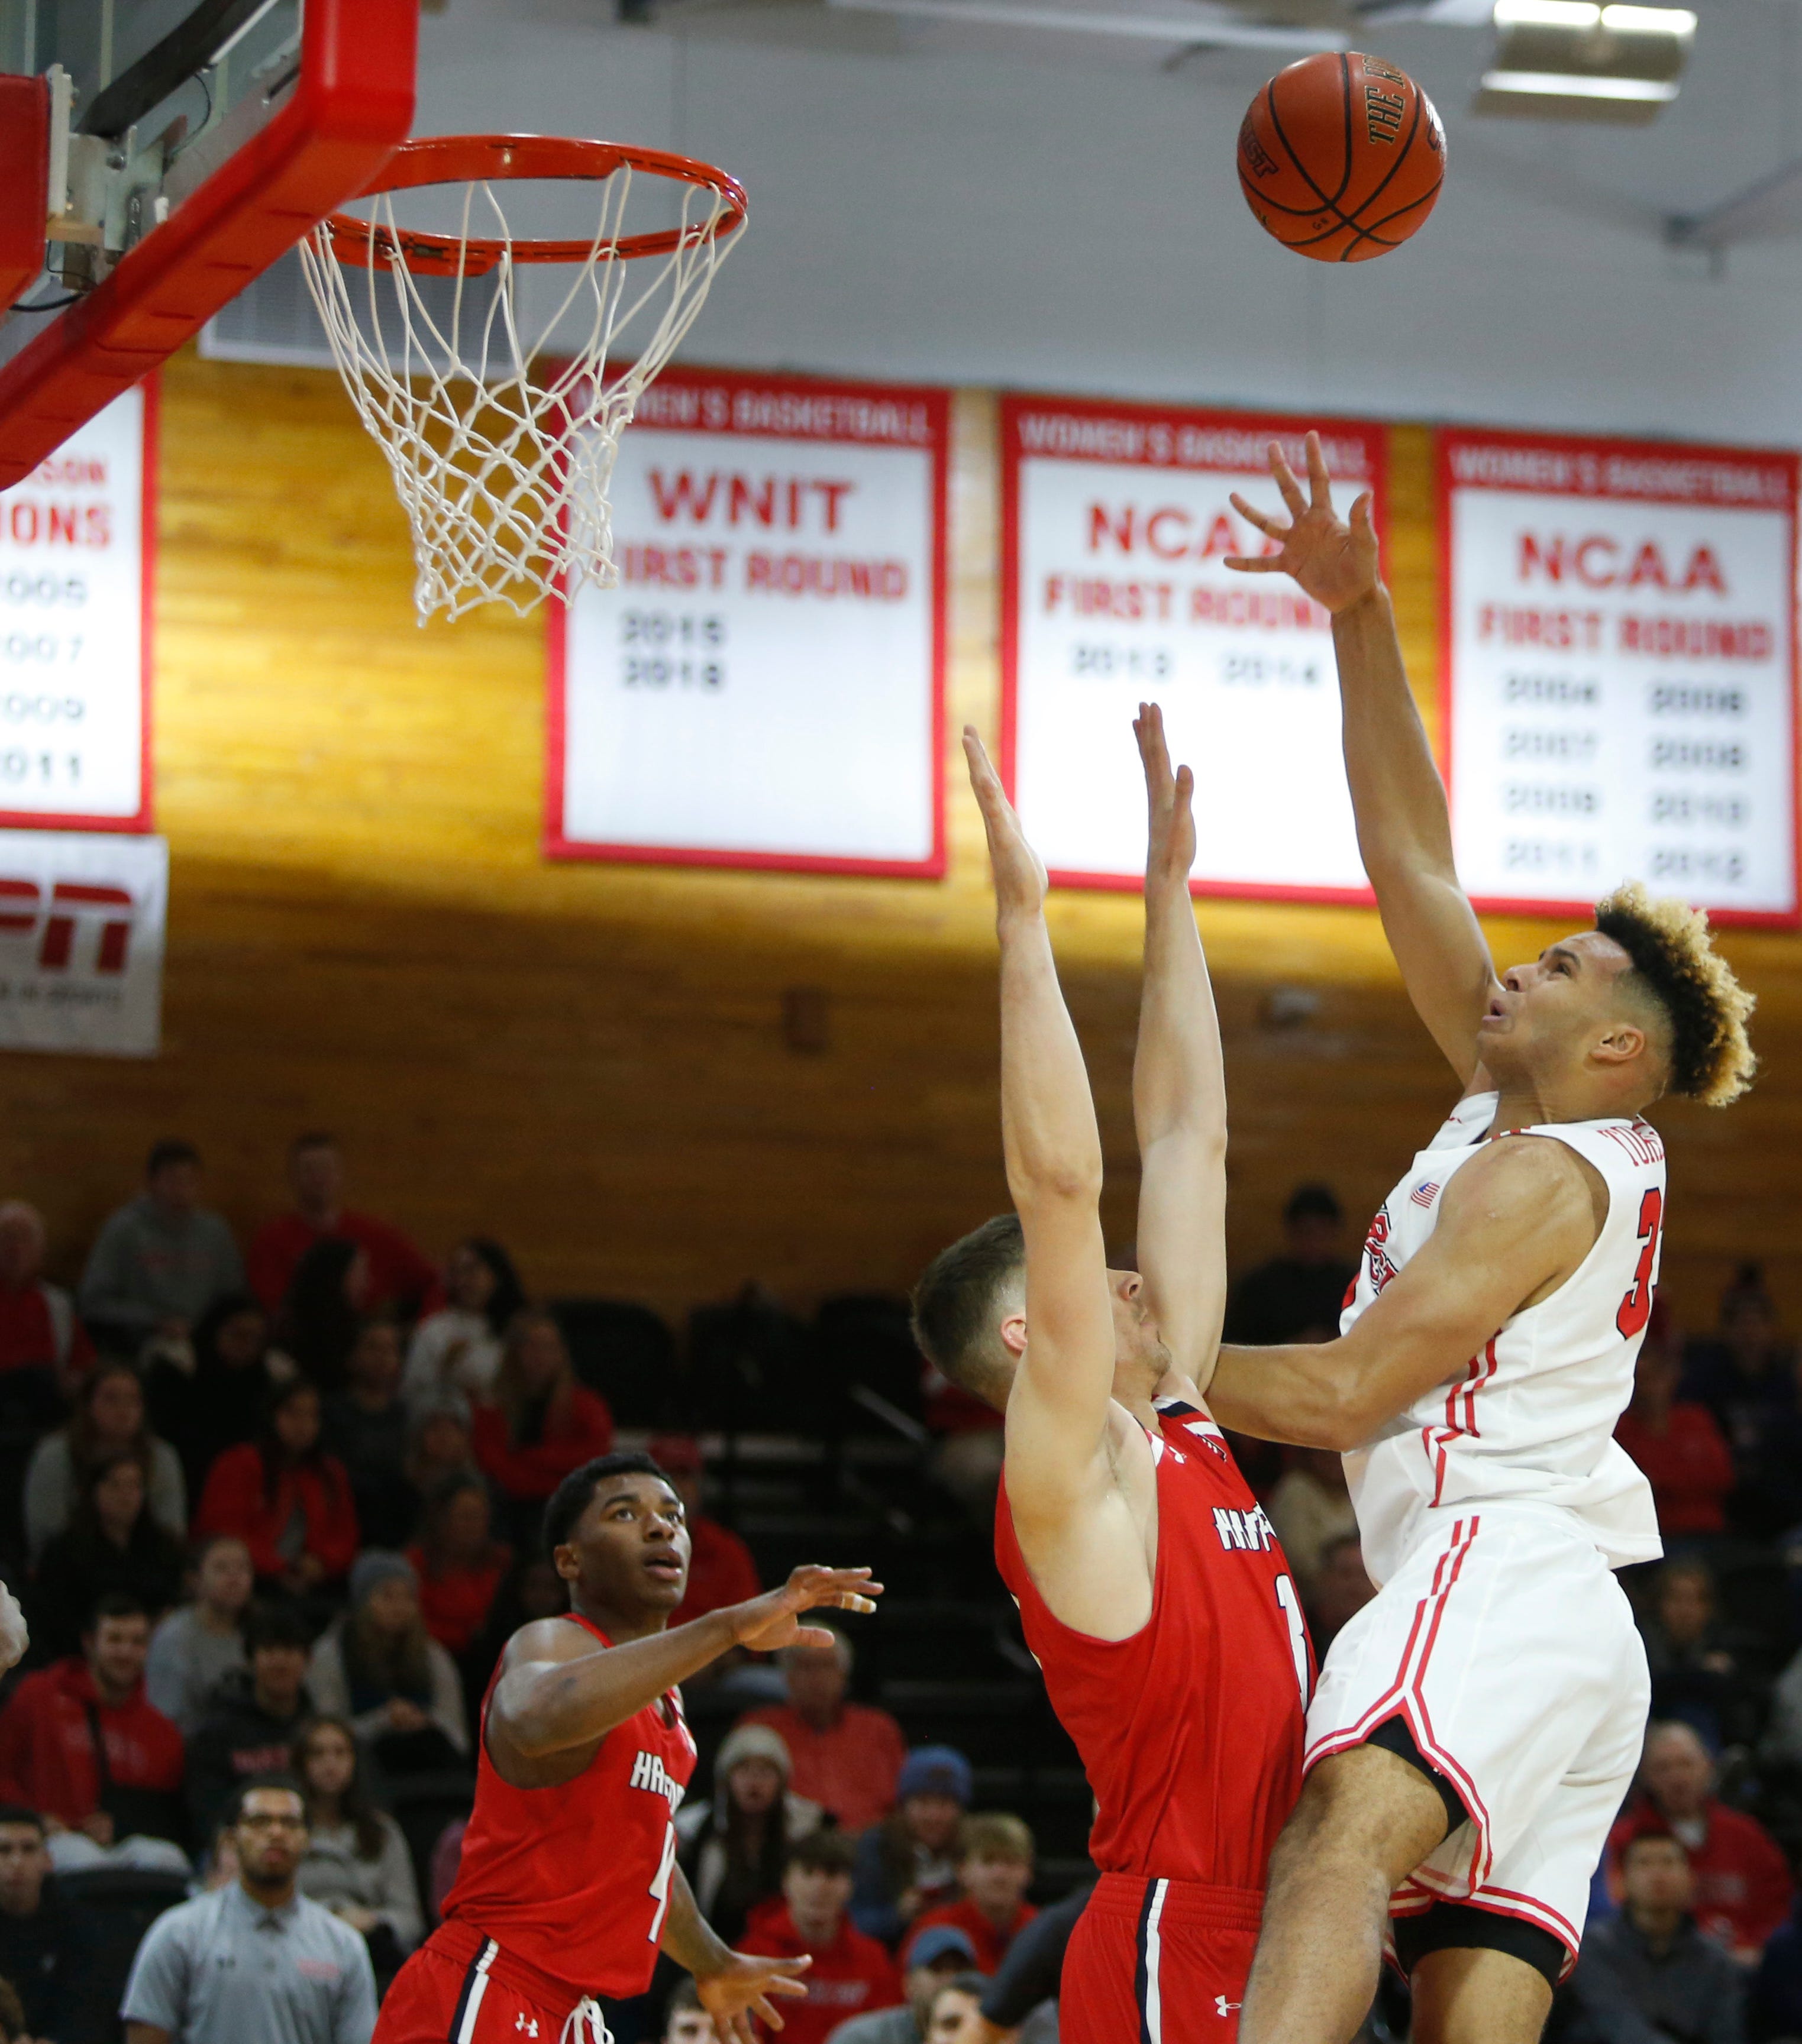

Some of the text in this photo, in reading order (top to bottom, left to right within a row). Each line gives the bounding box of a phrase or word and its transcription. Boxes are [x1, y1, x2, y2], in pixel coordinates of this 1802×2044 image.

[1364, 85, 1406, 145] THE
[733, 389, 929, 442] BASKETBALL
[1018, 415, 1172, 462] WOMEN'S
[648, 468, 855, 532] WNIT
[1449, 446, 1789, 508] WOMEN'S BASKETBALL
[747, 552, 909, 600] ROUND
[1519, 533, 1729, 596] NCAA
[1045, 573, 1173, 620] FIRST
[622, 609, 725, 645] 2015
[1479, 603, 1772, 659] FIRST ROUND
